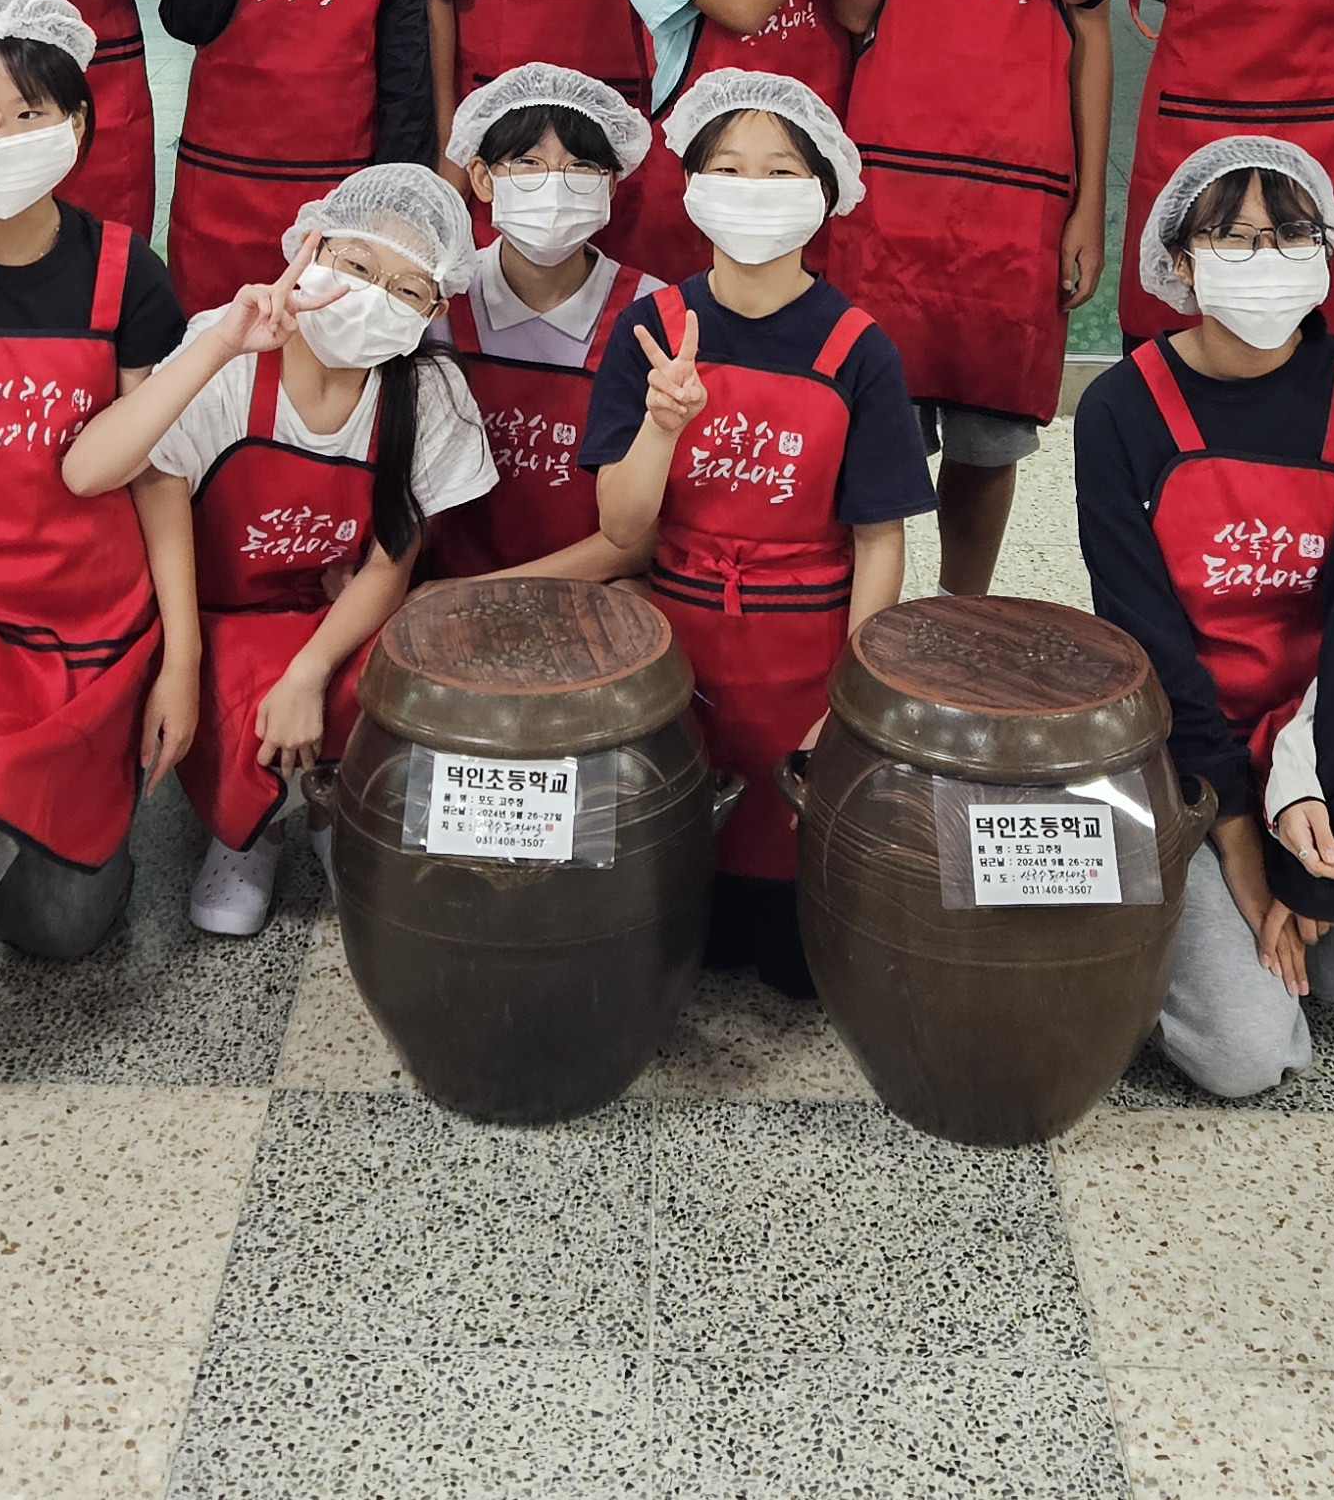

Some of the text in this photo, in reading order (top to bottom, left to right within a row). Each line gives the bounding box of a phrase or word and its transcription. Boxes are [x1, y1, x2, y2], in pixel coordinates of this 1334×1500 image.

[1214, 518, 1293, 563] 상록수
[447, 765, 568, 794] 덕인초등학교
[976, 816, 1102, 839] 덕인초등학교
[475, 836, 545, 848] 031)408-3507
[1037, 845, 1062, 854] 고추장
[1017, 858, 1047, 867] 2024년
[1022, 885, 1093, 895] 031)408-3507
